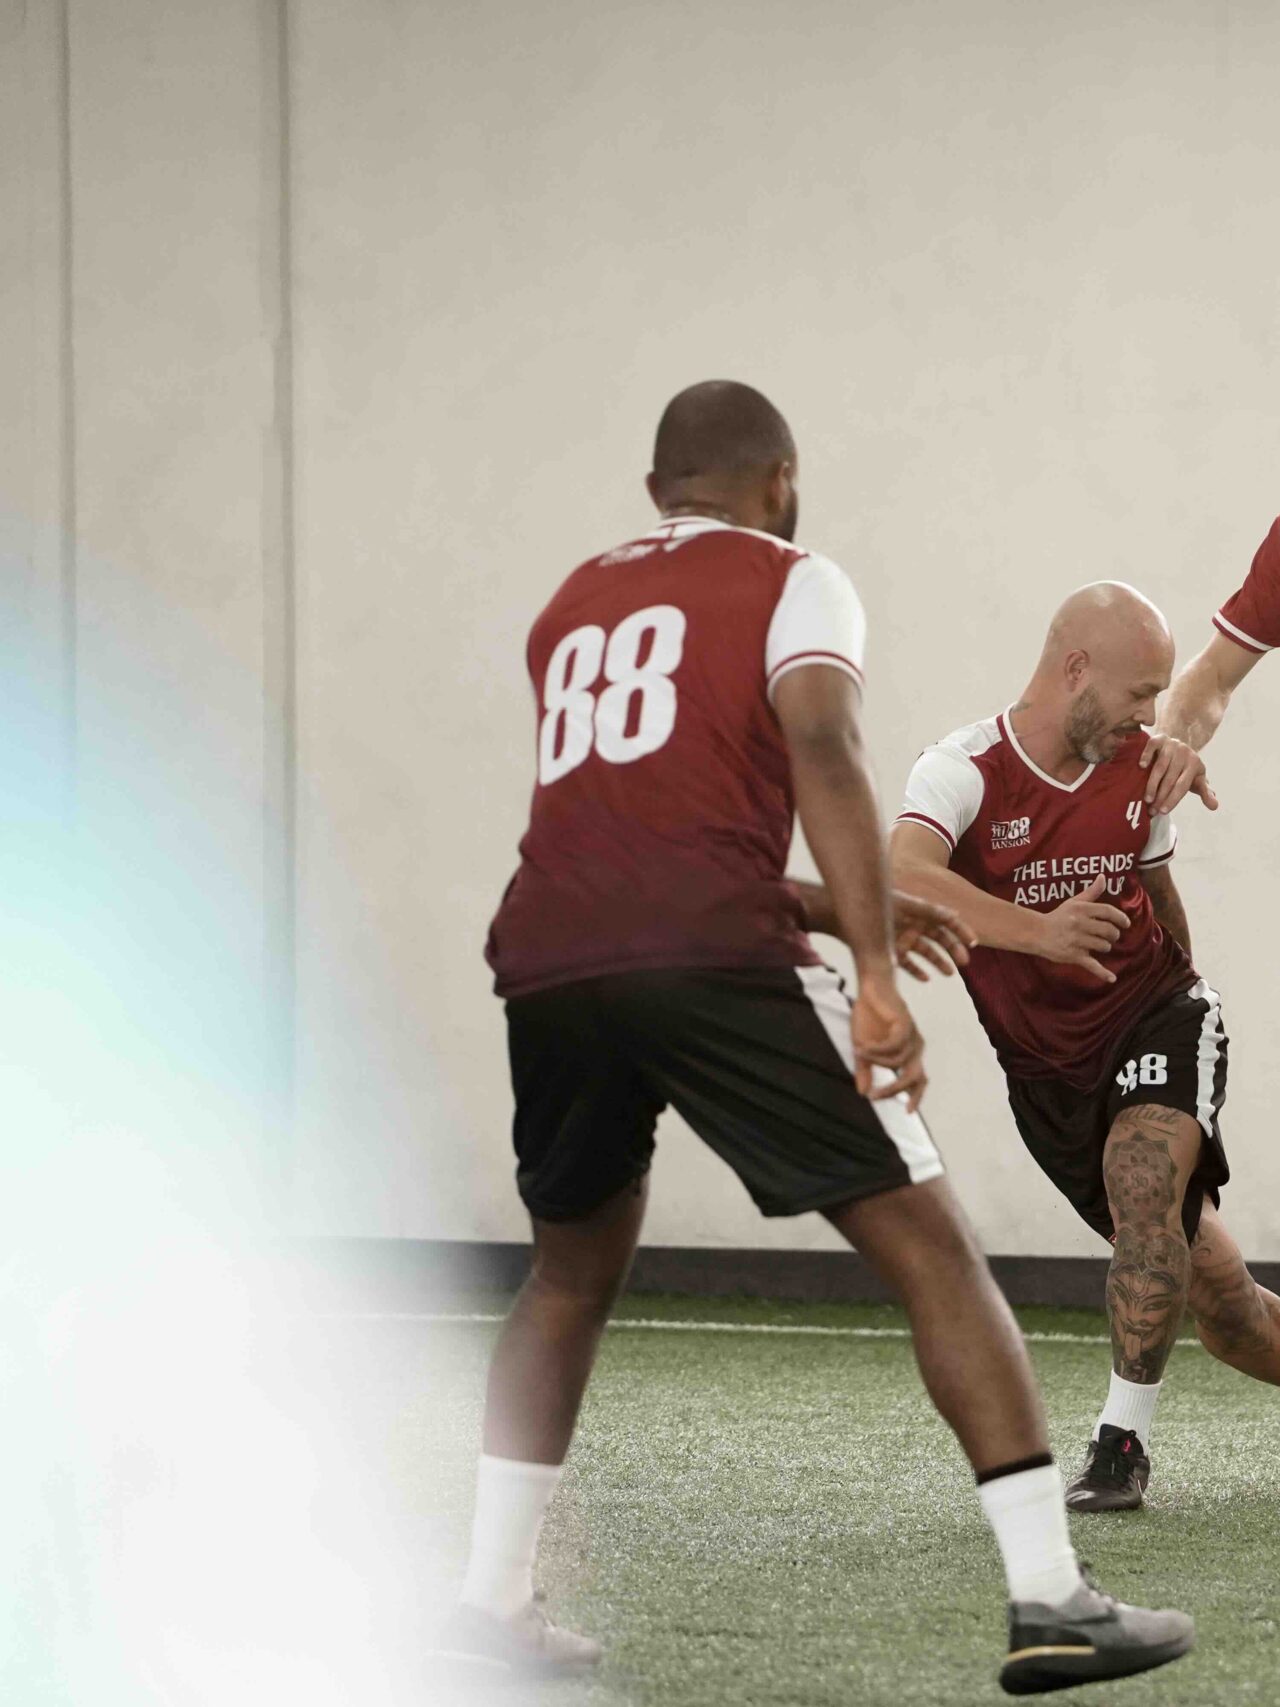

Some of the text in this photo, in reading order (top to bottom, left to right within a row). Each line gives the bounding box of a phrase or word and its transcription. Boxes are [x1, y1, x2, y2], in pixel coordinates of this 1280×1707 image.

[539, 604, 687, 786] 88
[1013, 852, 1135, 882] THE LEGENDS
[1014, 876, 1125, 905] ASIAN TUR
